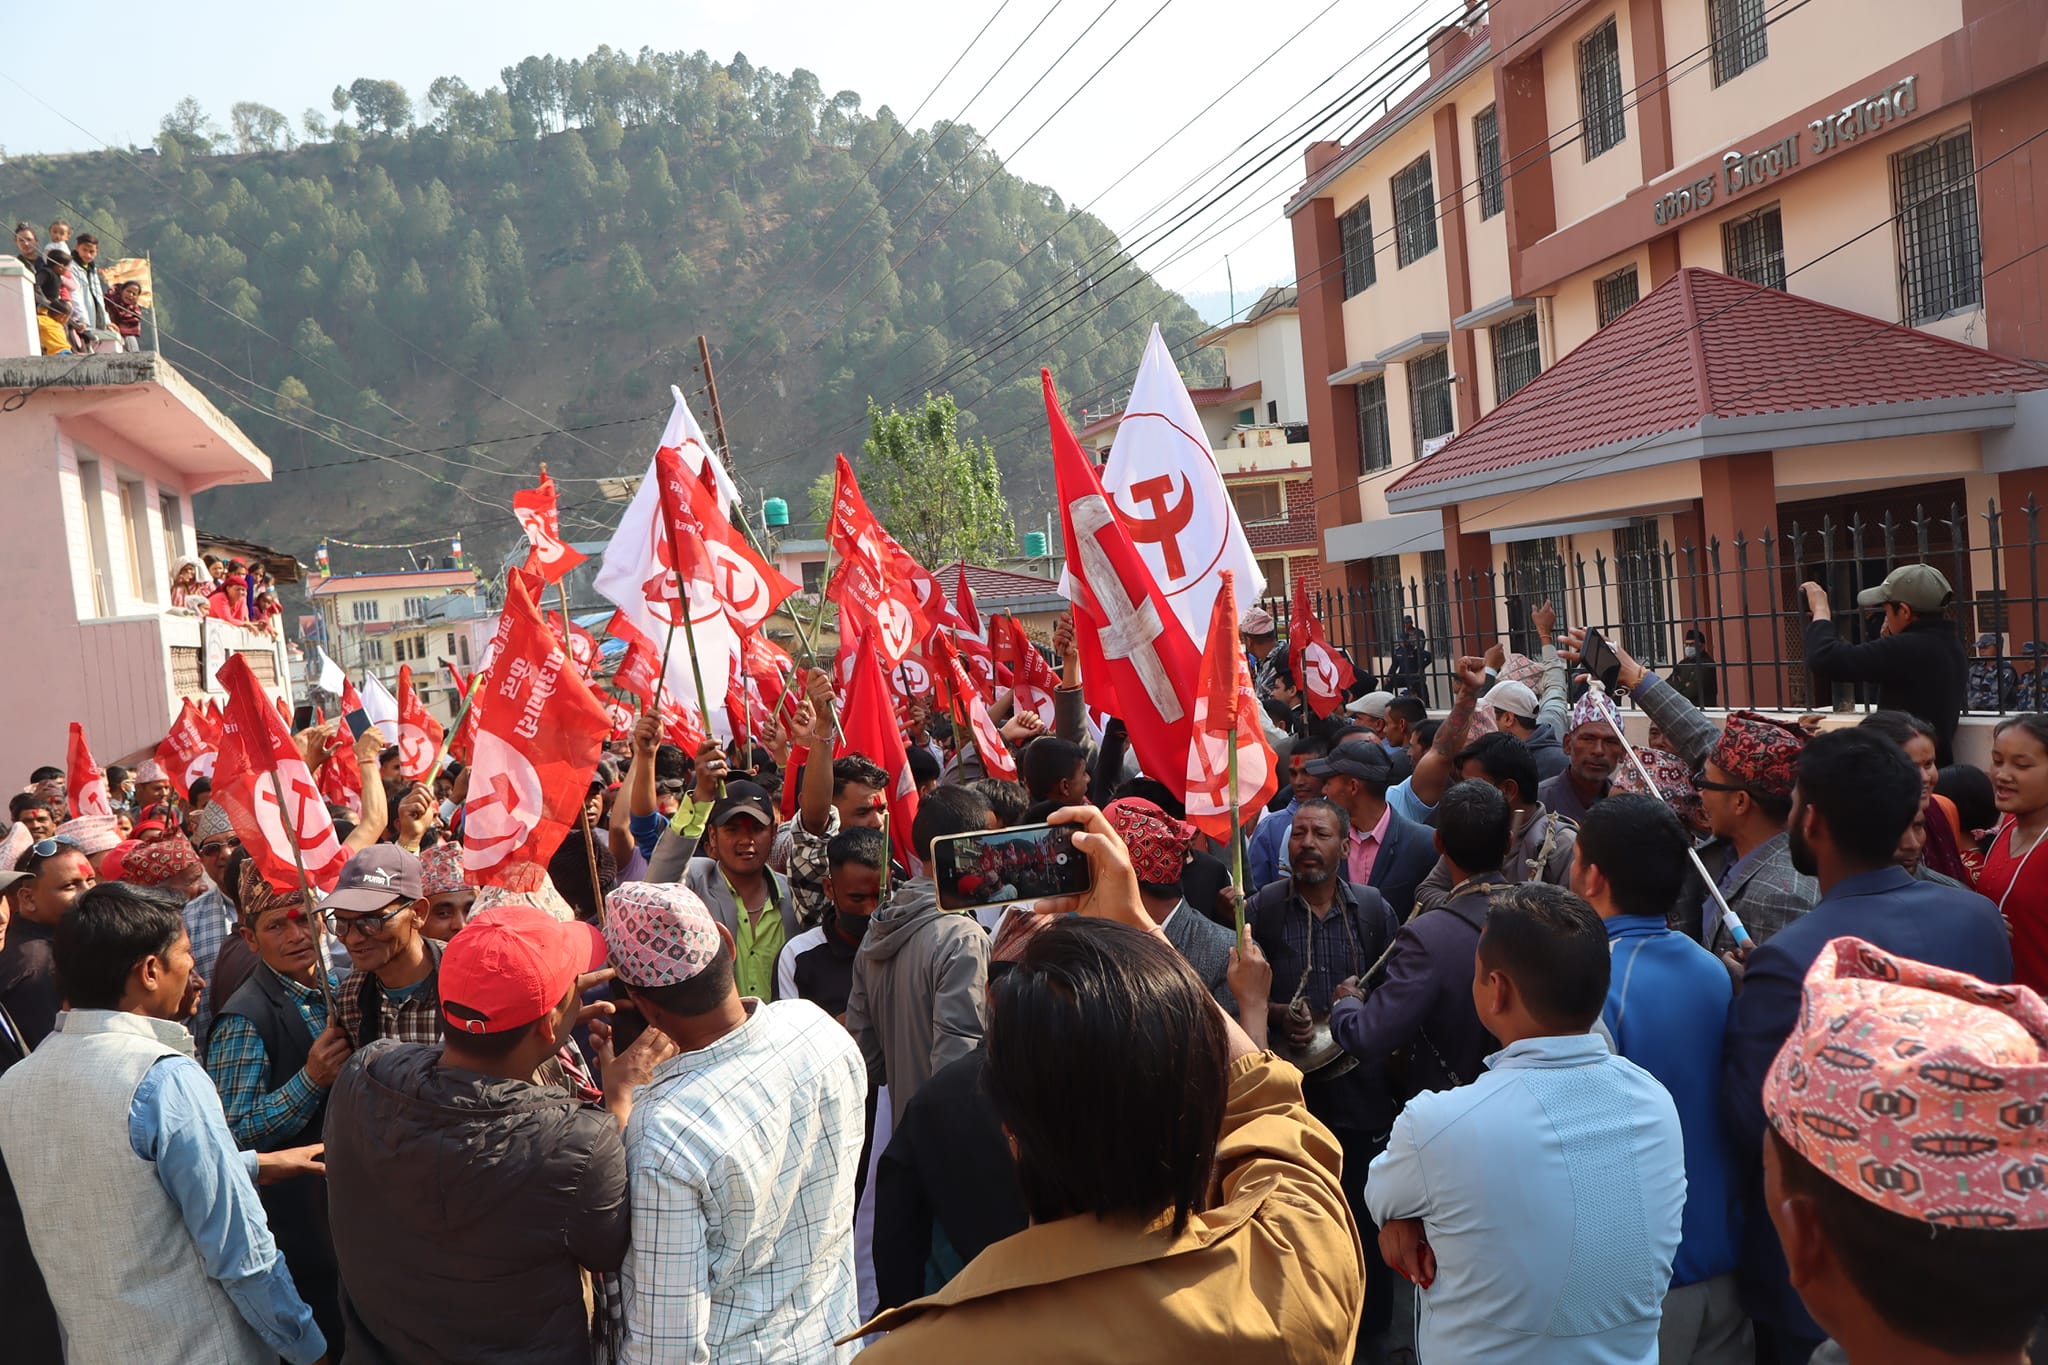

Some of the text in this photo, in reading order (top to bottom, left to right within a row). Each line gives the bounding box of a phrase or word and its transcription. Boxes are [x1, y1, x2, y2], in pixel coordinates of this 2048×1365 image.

[1722, 130, 1801, 196] जिल्ला
[1807, 73, 1919, 156] अदालत
[513, 646, 566, 739] माओवादी
[362, 874, 386, 885] PUMA
